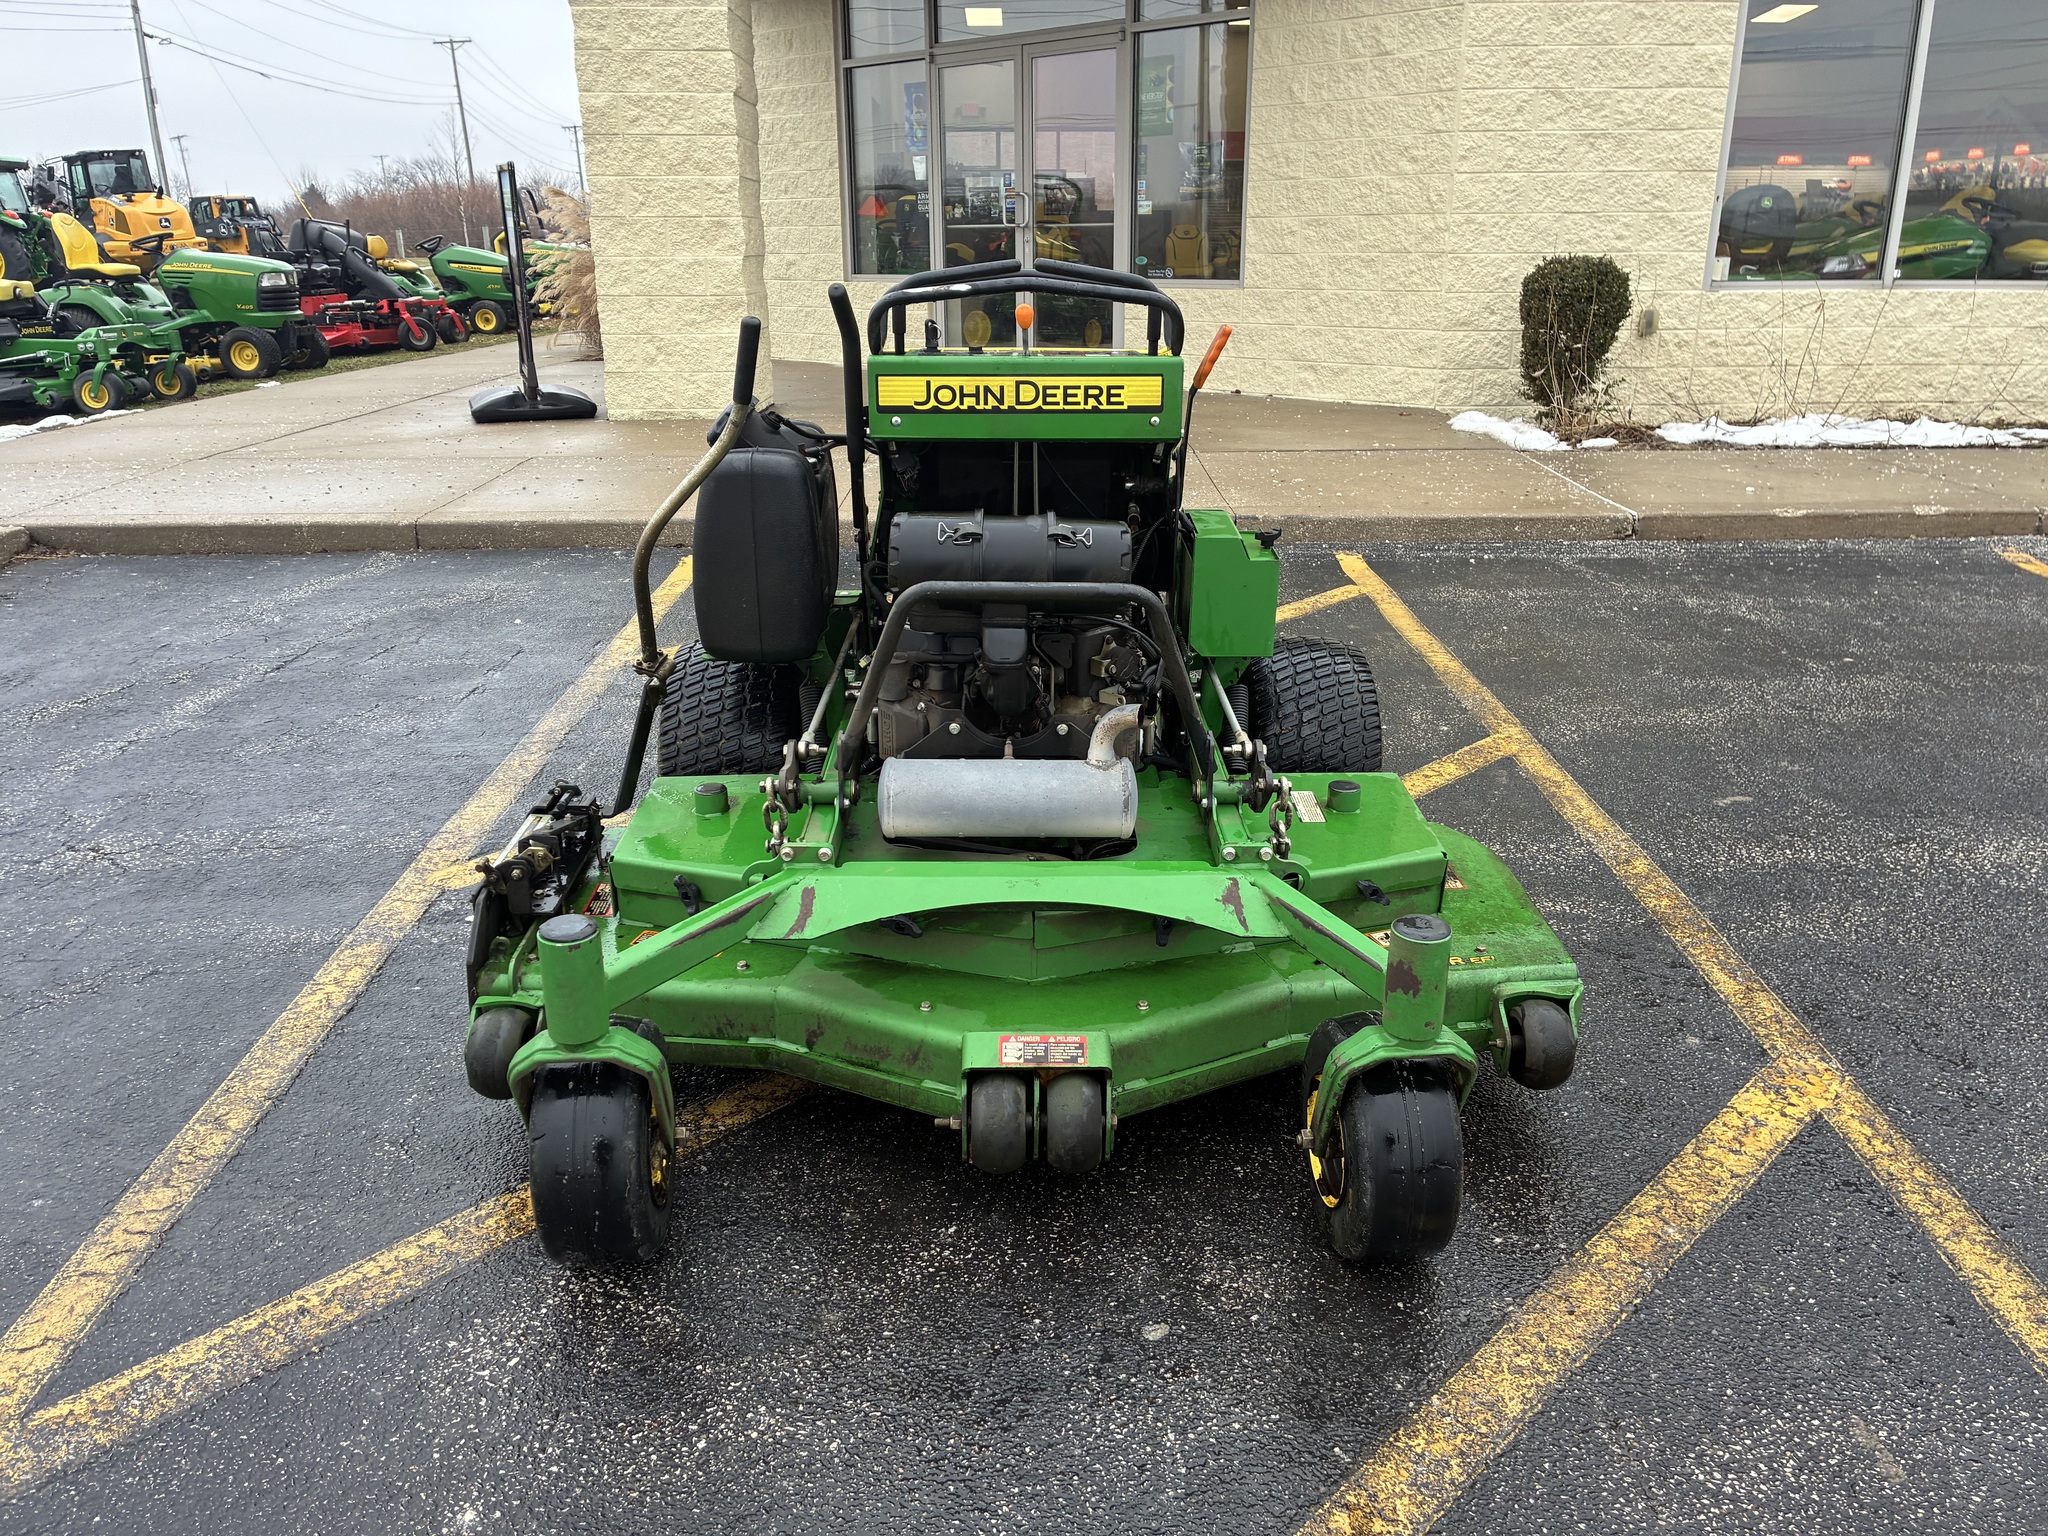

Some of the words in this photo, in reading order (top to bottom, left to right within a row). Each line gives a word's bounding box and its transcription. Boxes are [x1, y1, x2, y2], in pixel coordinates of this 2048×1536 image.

[20, 327, 36, 336] JOHN
[35, 325, 53, 334] DEERE
[913, 379, 1005, 408] JOHN
[1014, 380, 1126, 409] DEERE
